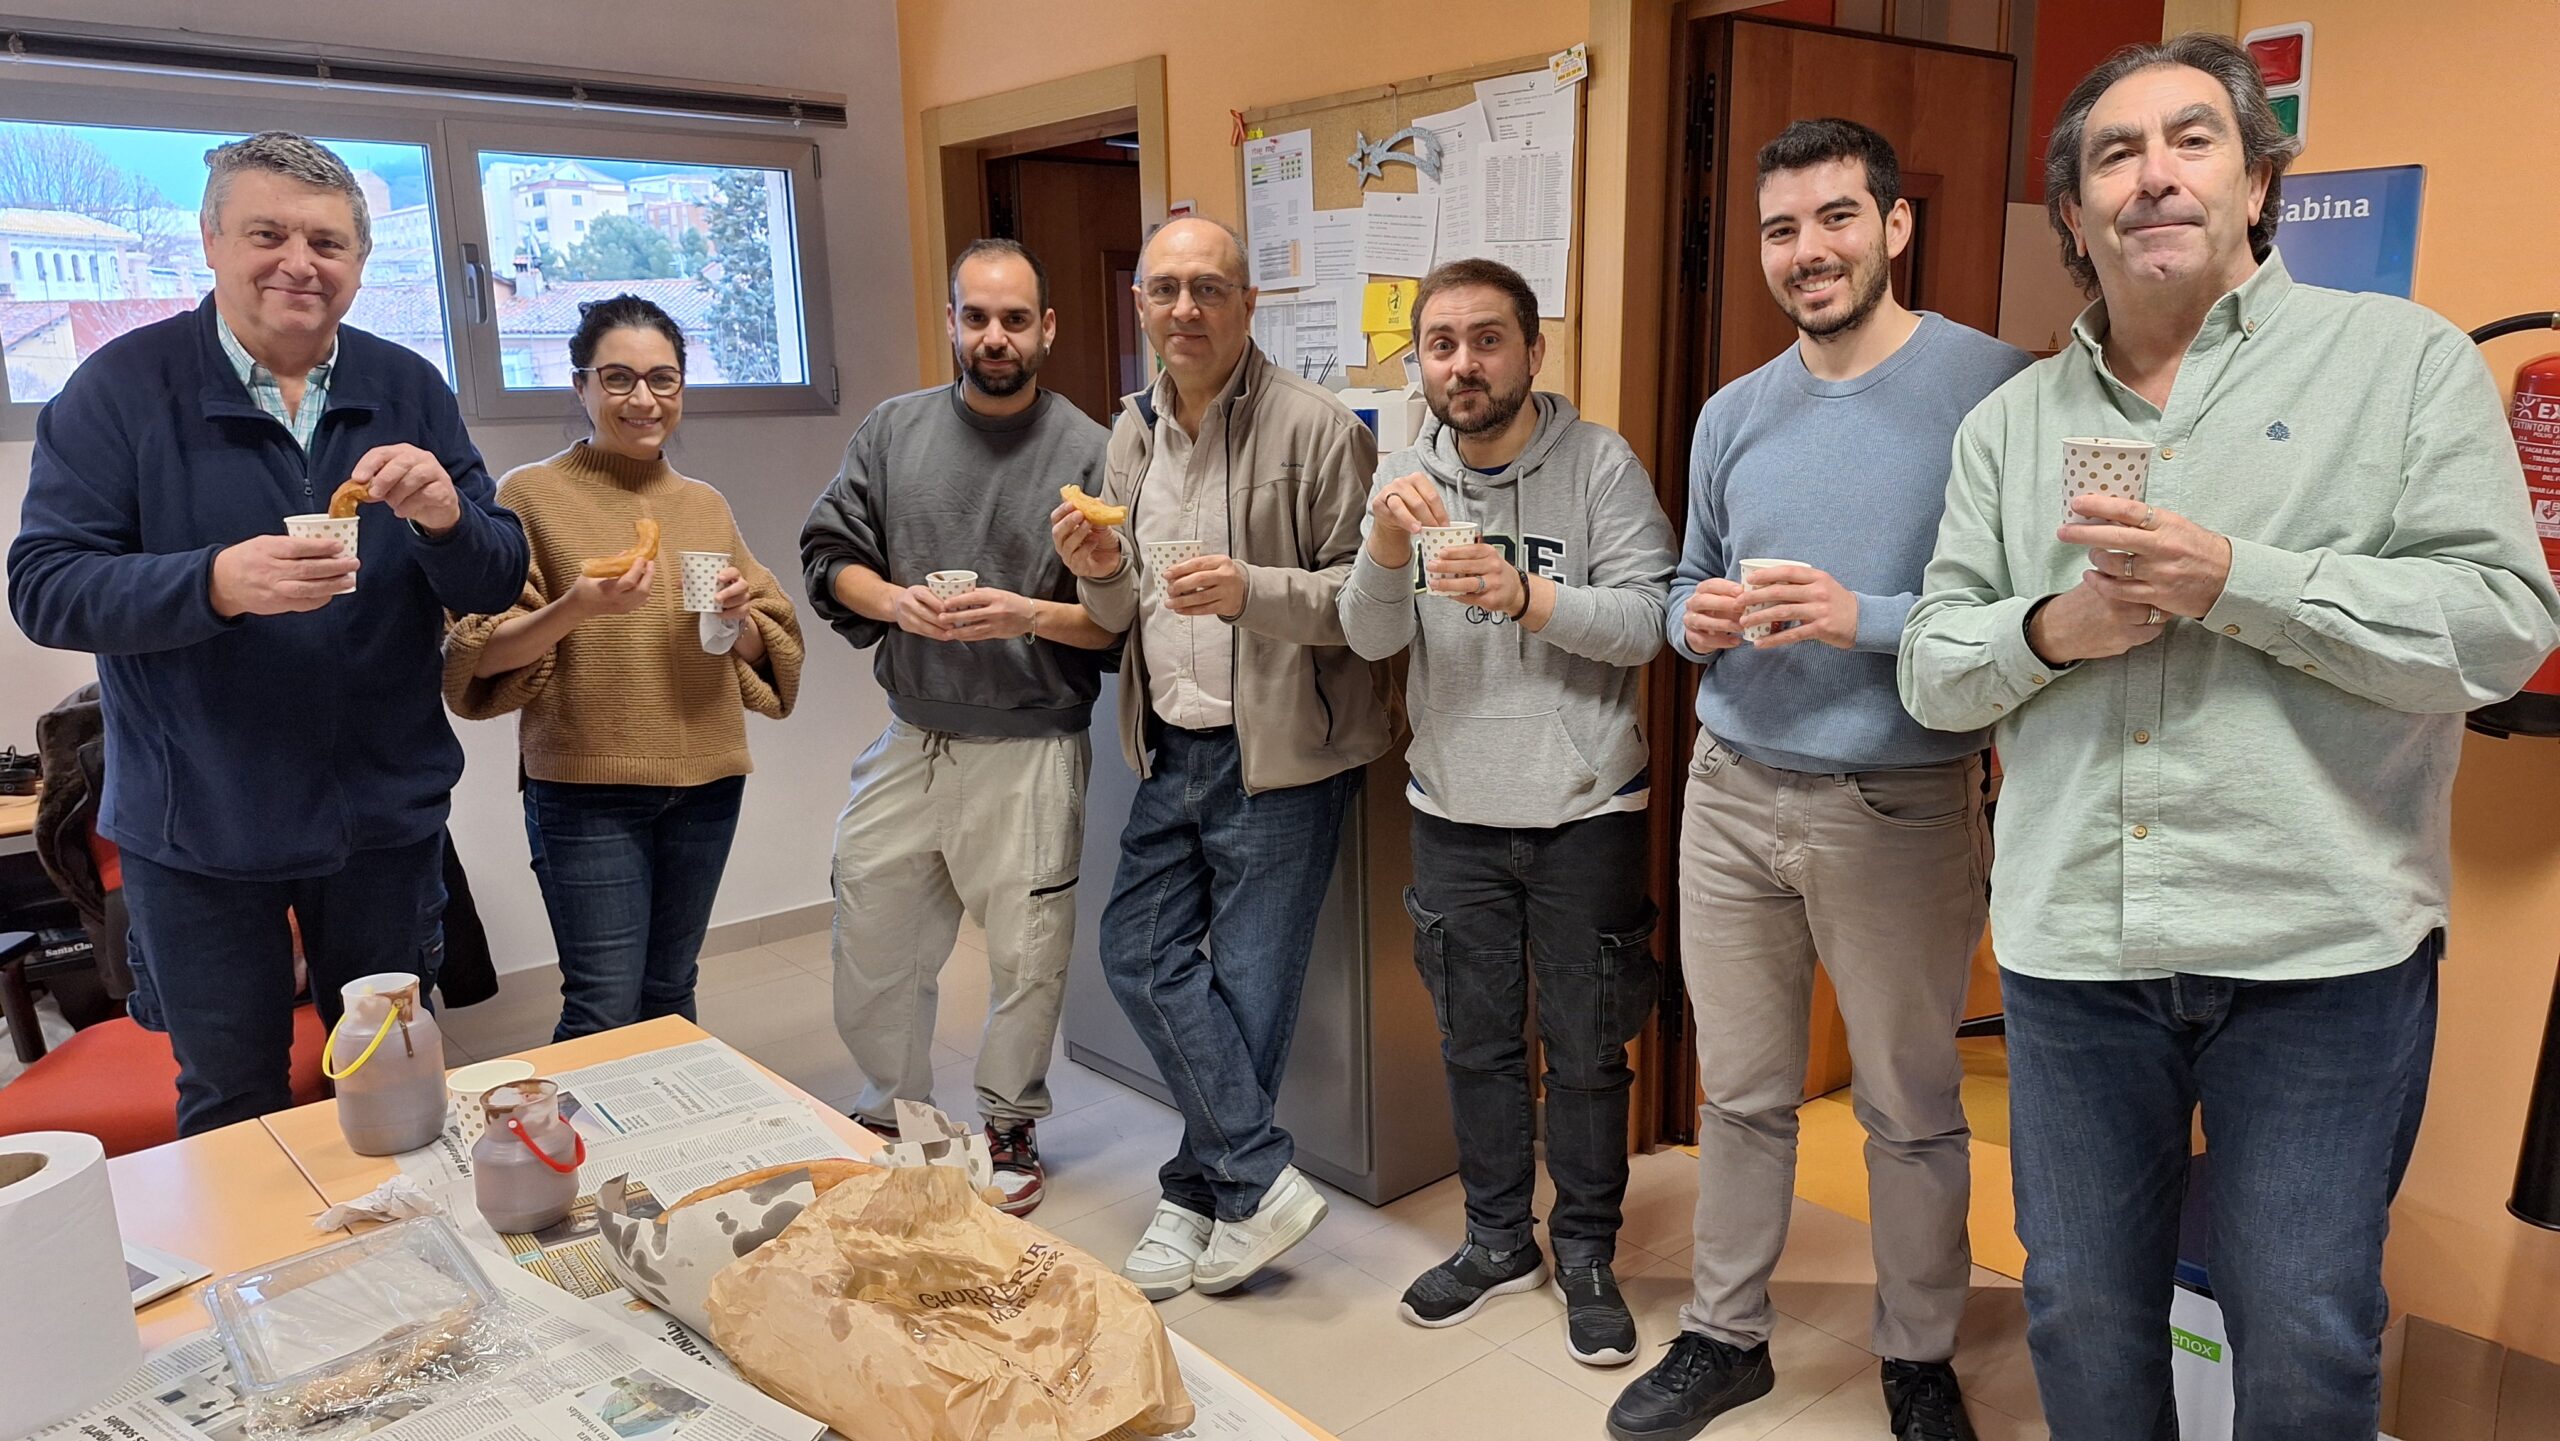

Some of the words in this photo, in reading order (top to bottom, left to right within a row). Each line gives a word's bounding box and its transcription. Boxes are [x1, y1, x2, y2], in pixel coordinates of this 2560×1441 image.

[2512, 420, 2551, 433] EXTINTOR
[45, 947, 73, 957] Santa
[2172, 1331, 2212, 1357] enox
